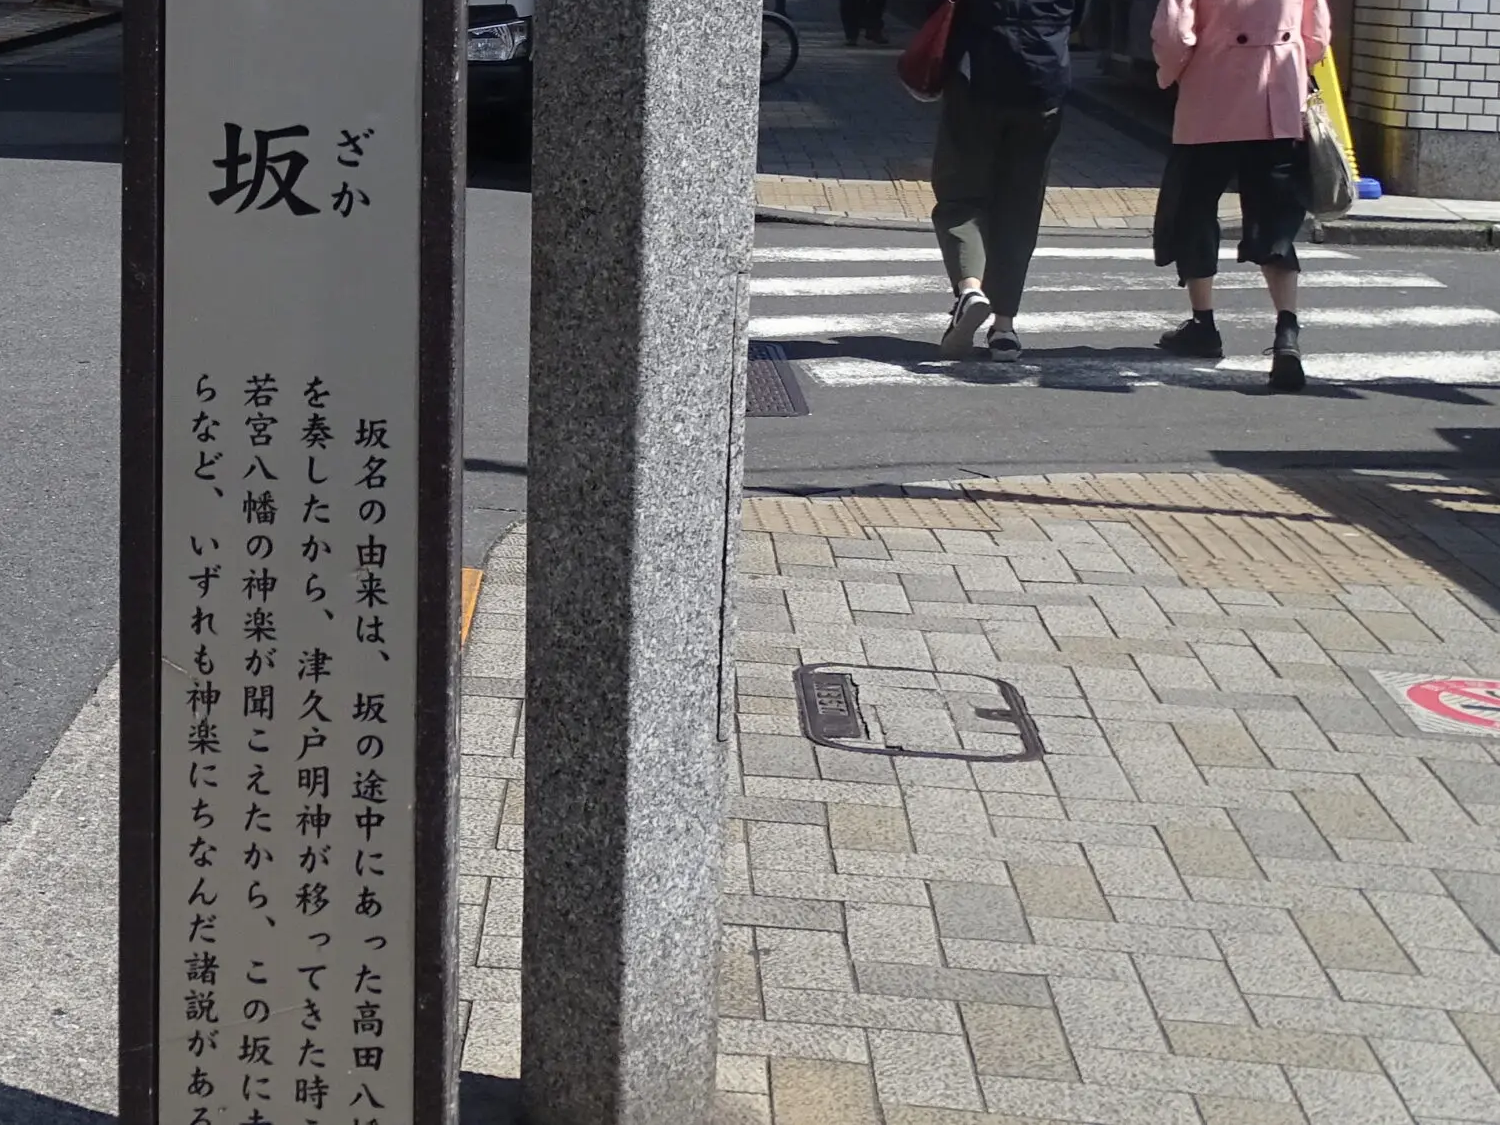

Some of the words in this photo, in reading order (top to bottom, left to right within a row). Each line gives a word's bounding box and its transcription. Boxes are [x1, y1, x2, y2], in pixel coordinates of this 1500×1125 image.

[294, 376, 335, 1125] を奏したから、津久戸明神が移ってきた時
[349, 418, 392, 1125] 坂名の由来は、坂の途中にあった高田八
